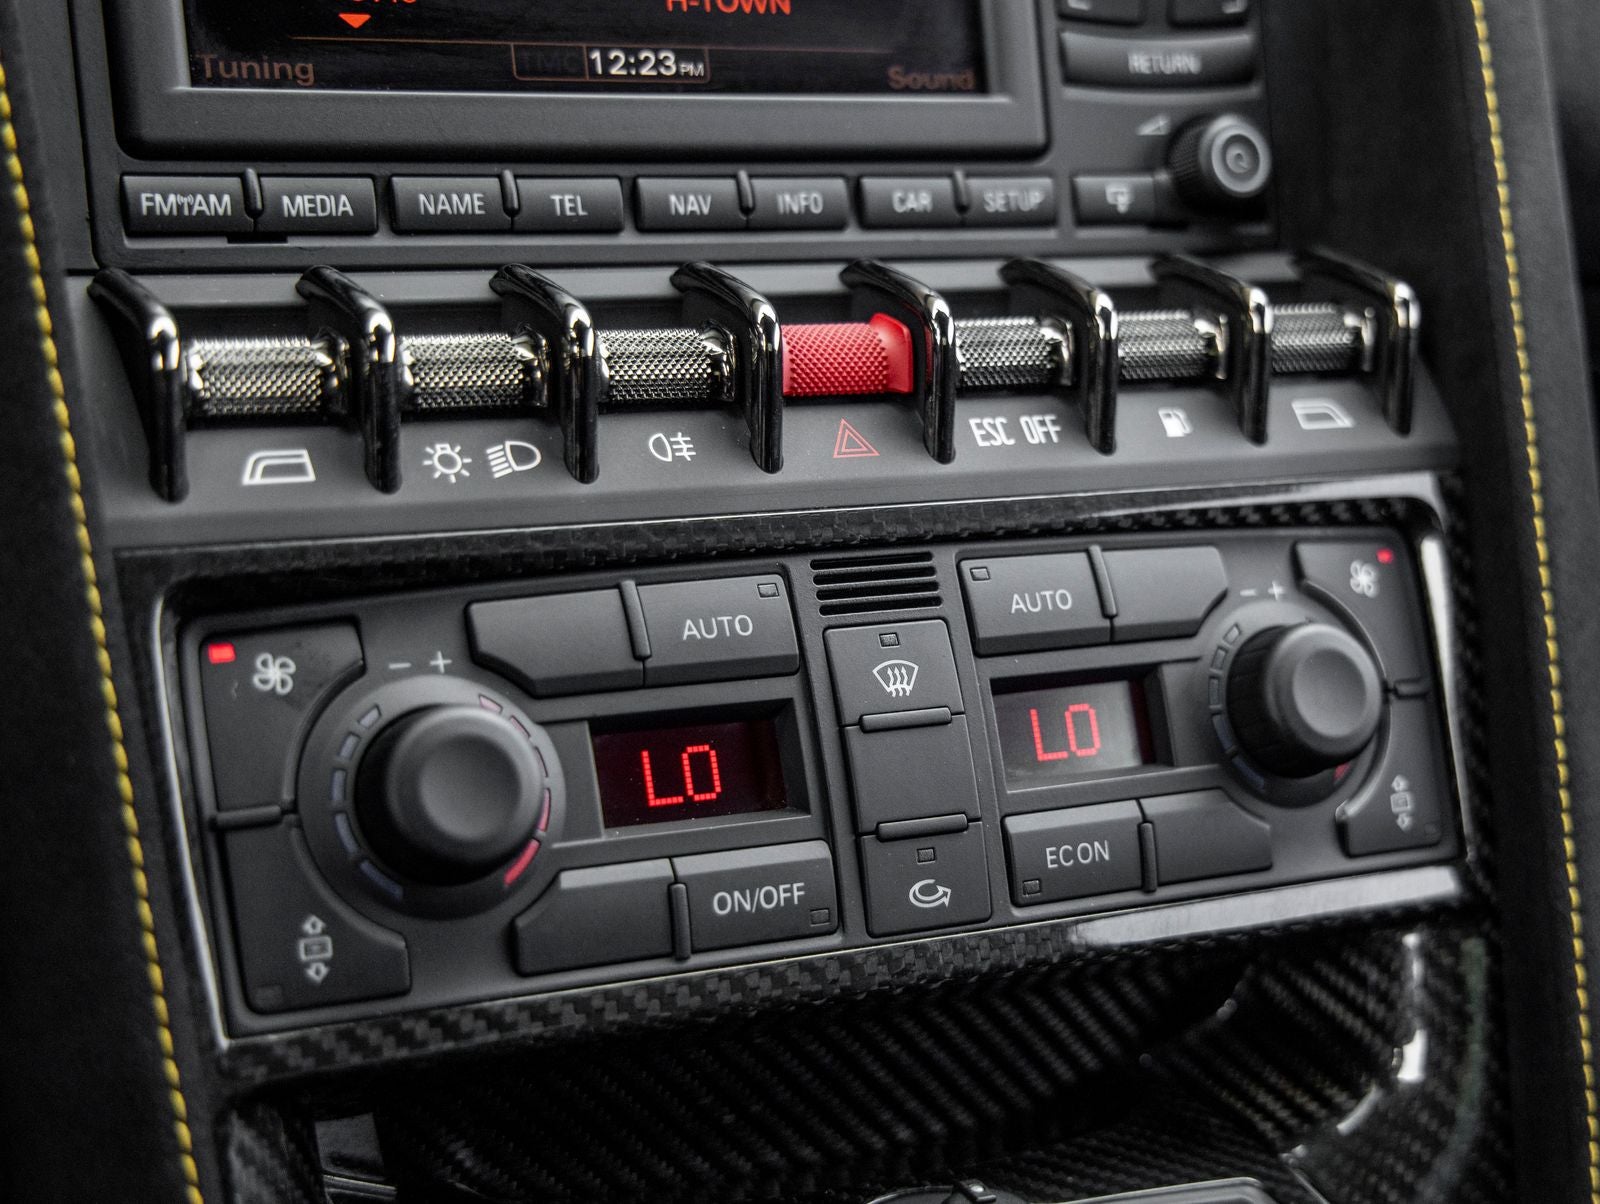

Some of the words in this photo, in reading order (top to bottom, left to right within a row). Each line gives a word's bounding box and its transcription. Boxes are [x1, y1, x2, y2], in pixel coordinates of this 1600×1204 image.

[196, 54, 315, 87] Tuning
[1128, 53, 1201, 75] RETURN
[887, 66, 976, 90] Sound
[282, 194, 354, 218] MEDIA
[418, 193, 486, 215] NAME
[550, 195, 588, 216] TEL
[669, 193, 712, 215] NAV
[776, 192, 824, 214] INFO
[893, 191, 933, 213] CAR
[983, 191, 1046, 213] SETUP
[968, 416, 1016, 447] ESC
[1019, 413, 1061, 444] OFF
[1010, 588, 1073, 614] AUTO
[682, 614, 754, 641] AUTO
[1030, 703, 1101, 762] LO
[641, 744, 723, 807] LO
[1045, 839, 1110, 869] ECON
[713, 882, 806, 915] ON/OFF
